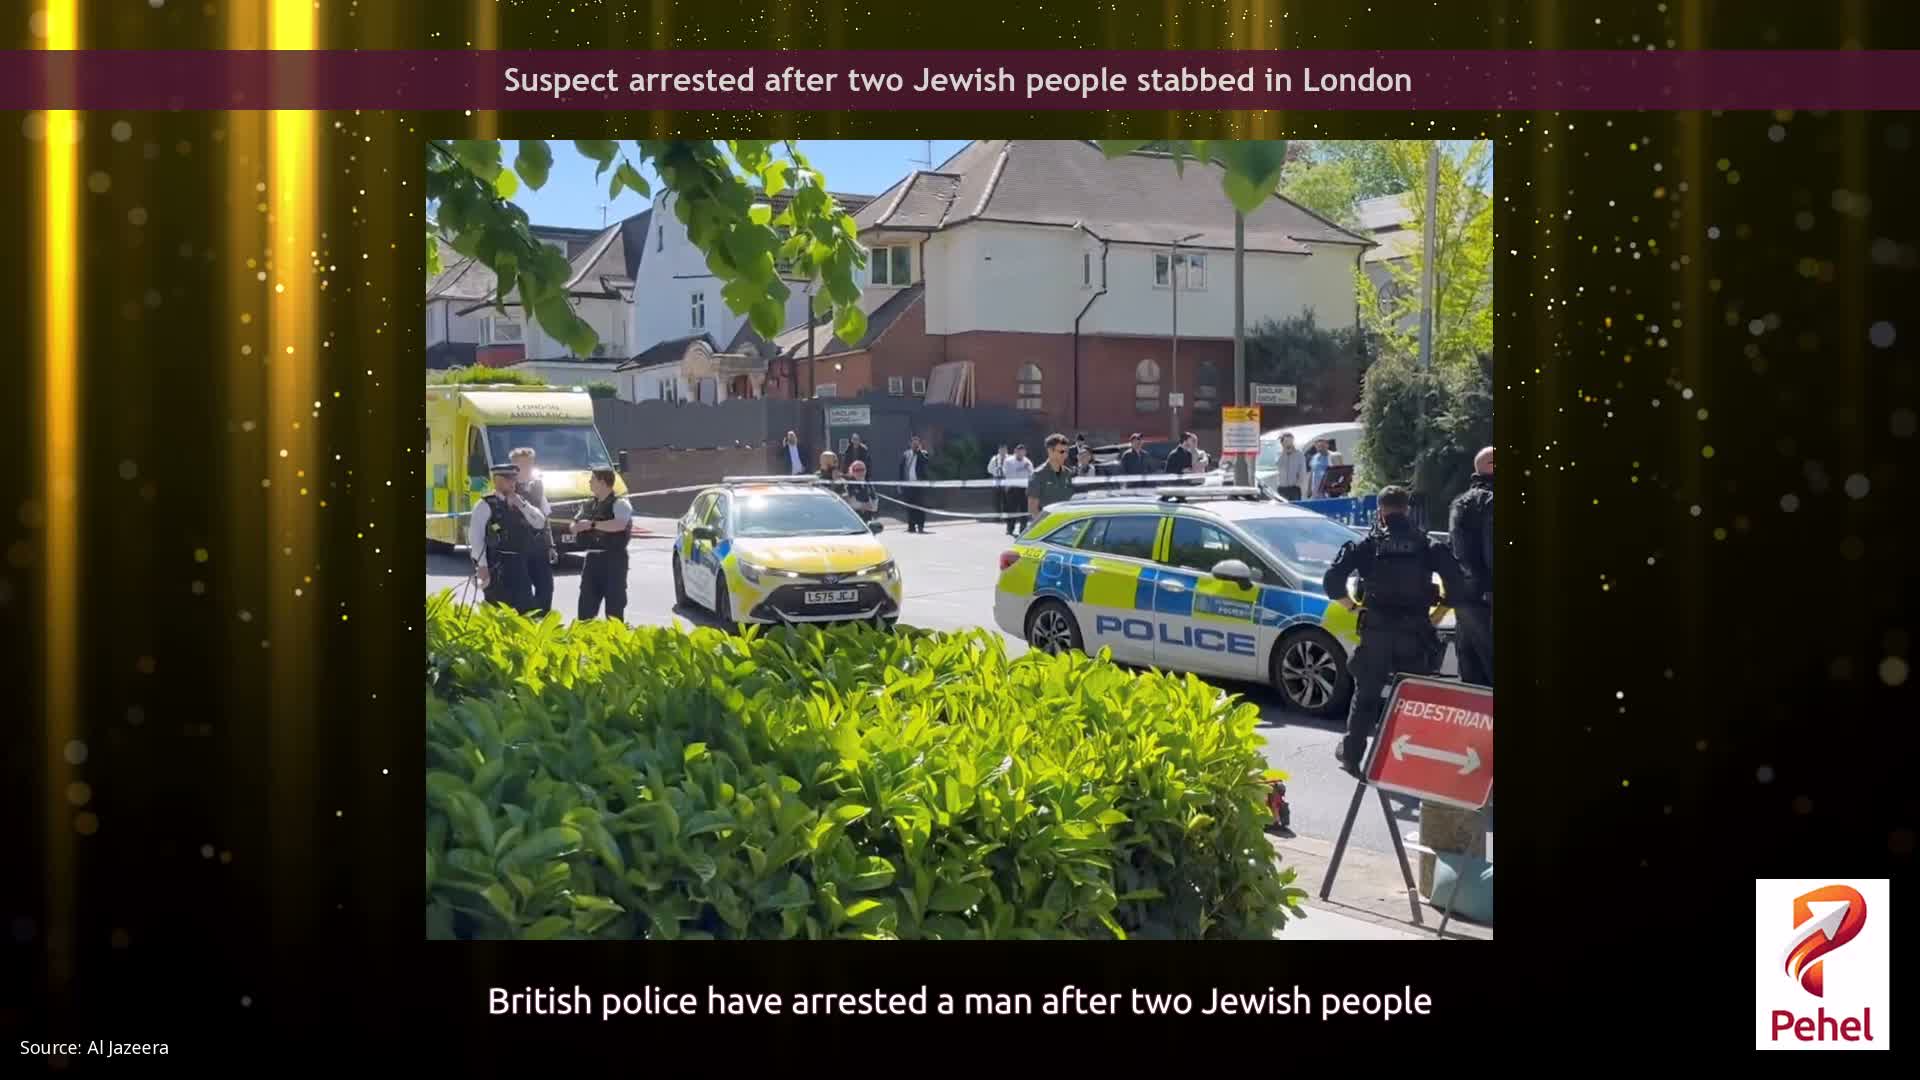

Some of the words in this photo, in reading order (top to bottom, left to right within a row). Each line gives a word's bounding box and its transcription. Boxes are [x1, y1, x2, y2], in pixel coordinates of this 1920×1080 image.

[808, 591, 834, 602] LS75
[1096, 614, 1257, 658] POLICE
[1394, 698, 1493, 731] PEDESTRIAN
